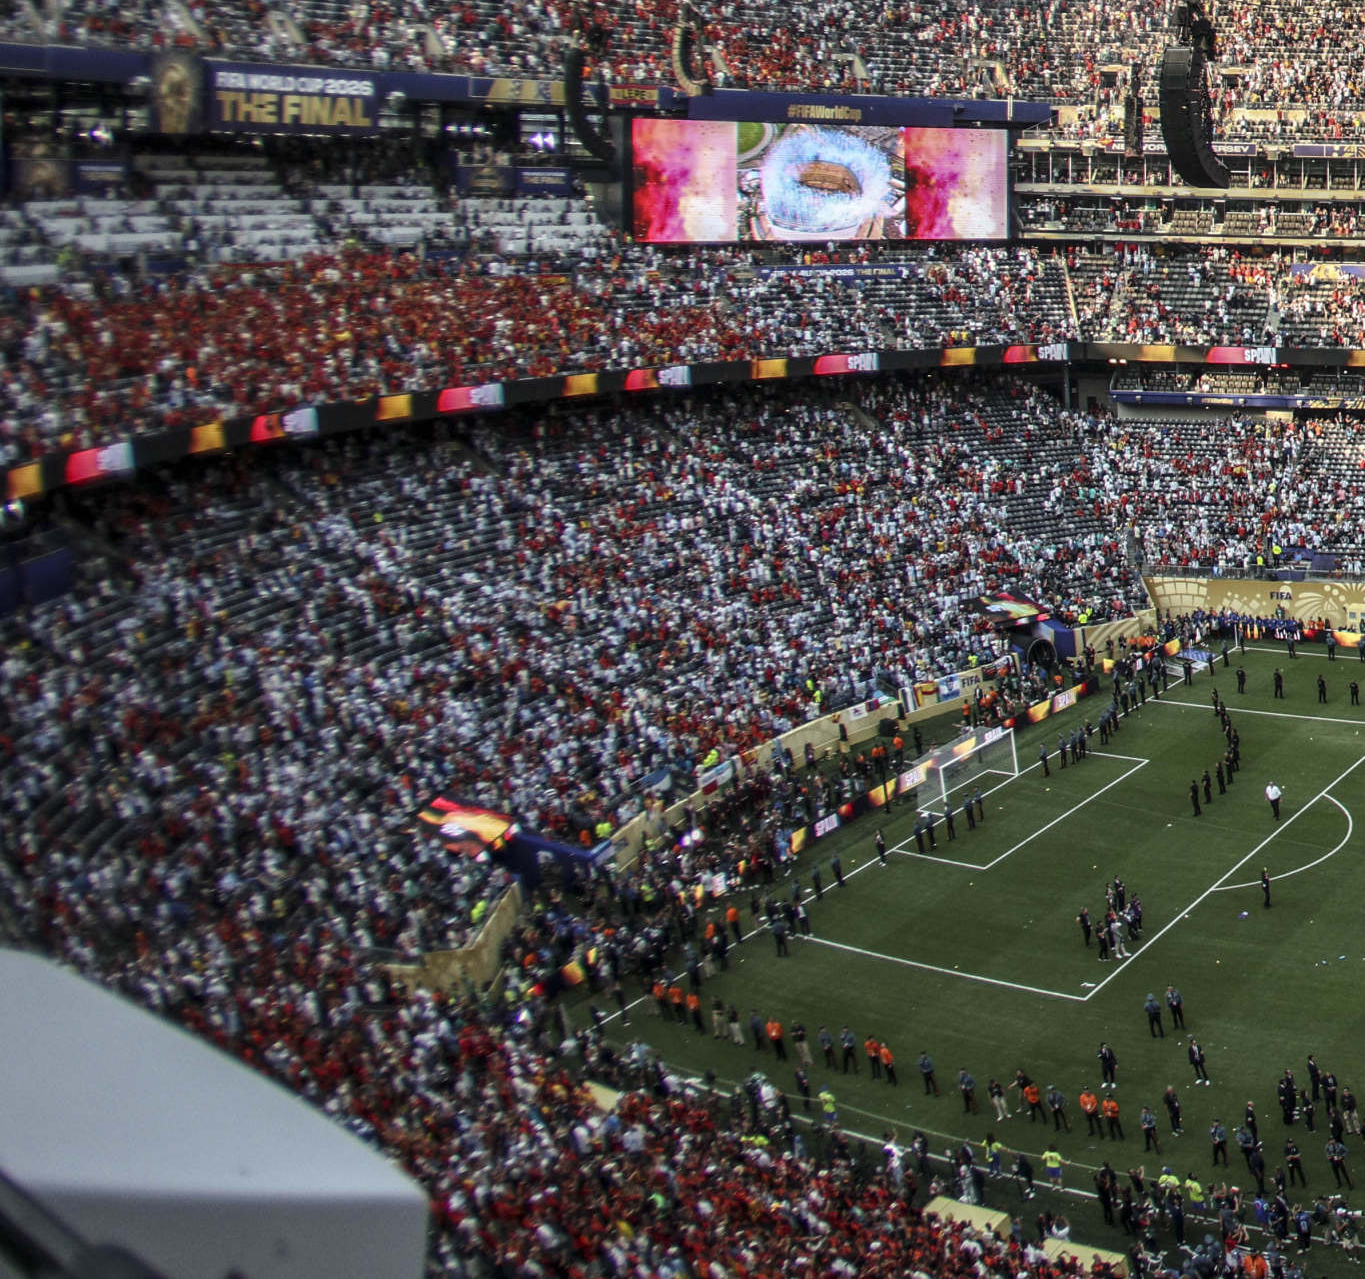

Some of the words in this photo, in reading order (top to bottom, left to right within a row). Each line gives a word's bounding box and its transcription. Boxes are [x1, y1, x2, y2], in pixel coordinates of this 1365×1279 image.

[324, 79, 374, 95] 2026
[216, 91, 279, 123] THE
[282, 95, 372, 127] FINAL
[787, 104, 862, 122] #FIFAWorldCup
[1038, 343, 1069, 361] SPAIN
[1244, 352, 1277, 370] SPAIN
[1270, 591, 1292, 601] FIFA
[962, 674, 980, 688] FIFA
